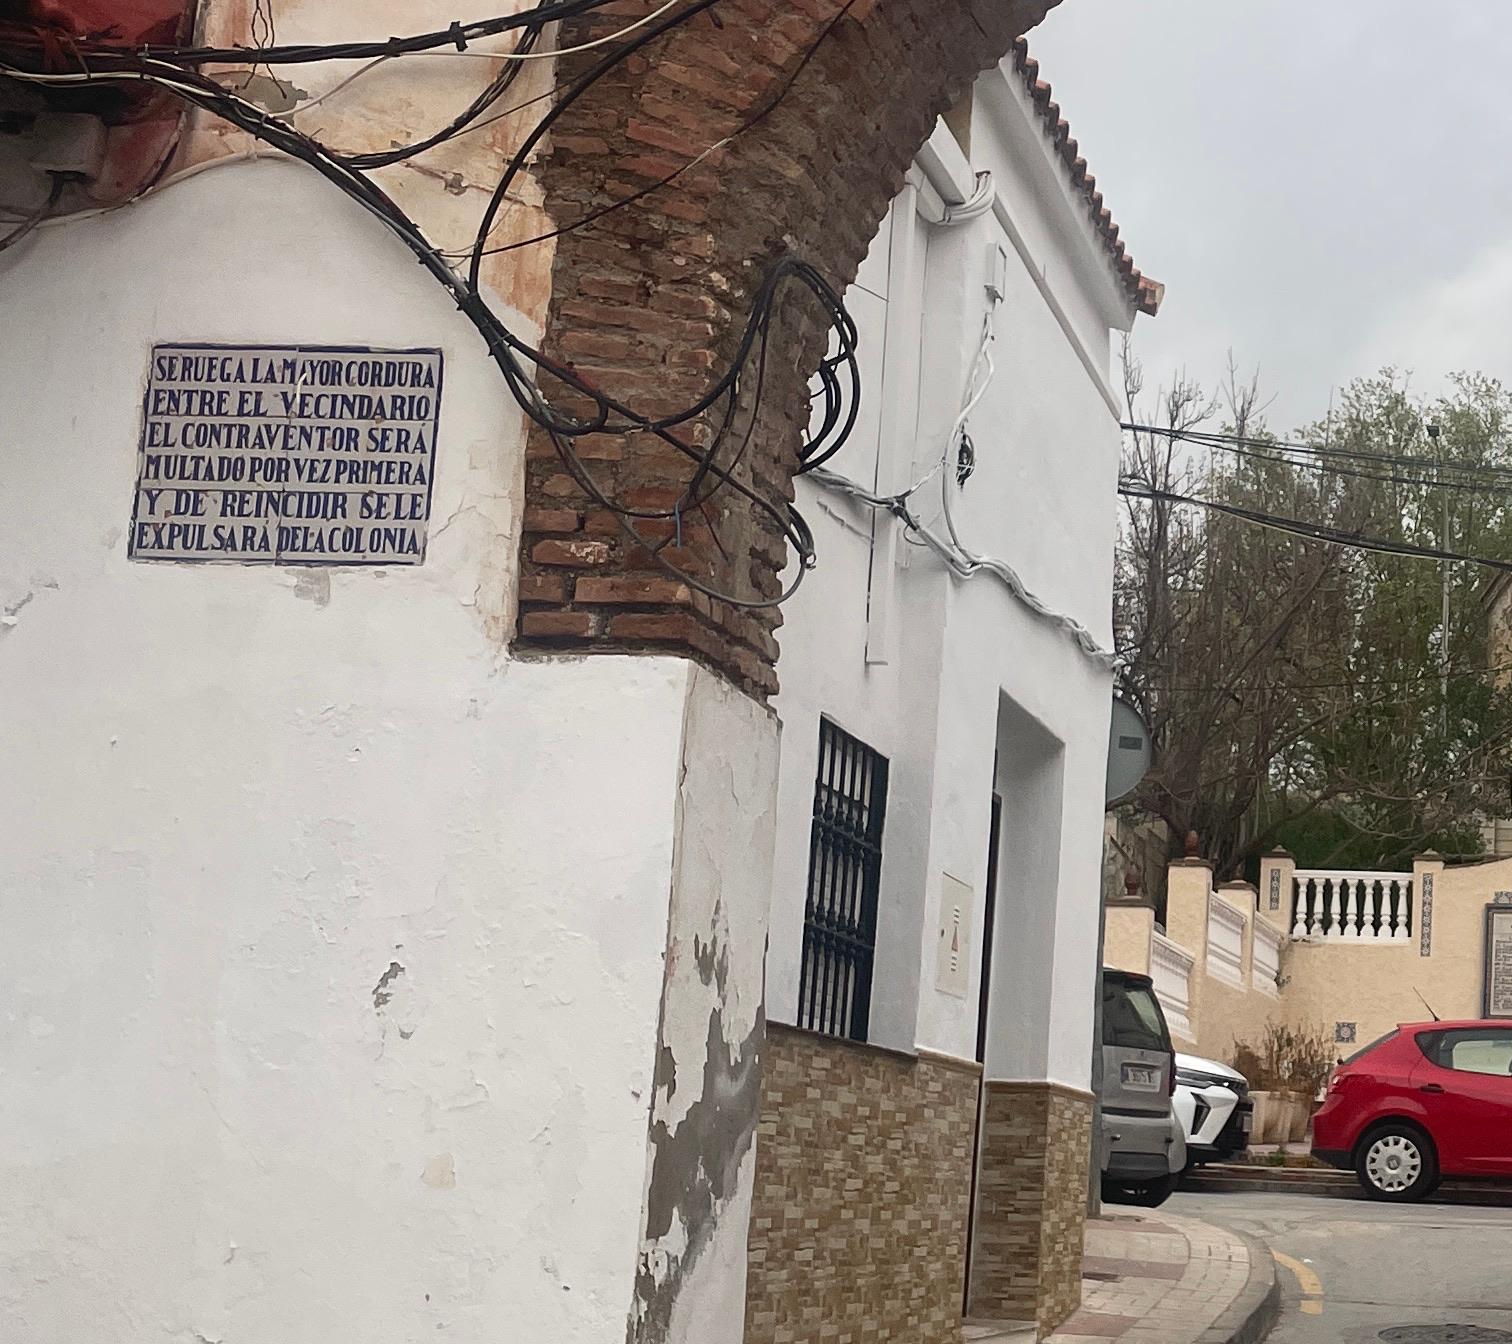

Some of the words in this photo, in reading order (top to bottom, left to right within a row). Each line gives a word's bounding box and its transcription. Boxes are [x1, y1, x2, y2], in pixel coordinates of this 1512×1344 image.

[250, 357, 277, 384] LA
[280, 357, 343, 386] MAYOR
[345, 361, 435, 388] CORDURA
[152, 389, 230, 417] ENTRE
[236, 391, 268, 417] EL
[280, 391, 431, 421] VECINDARIO
[147, 422, 177, 448] EL
[181, 422, 359, 452] CONTRAVENTOR
[144, 455, 245, 482] MULTADO
[248, 457, 290, 483] POR
[293, 458, 332, 484] VEZ
[334, 458, 427, 486] PRIMERA
[141, 489, 163, 515] Y
[173, 489, 207, 516] DE
[219, 491, 347, 520] REINCIDIR
[359, 491, 391, 519] SE
[393, 493, 424, 520] LE
[328, 527, 420, 554] COLONIA
